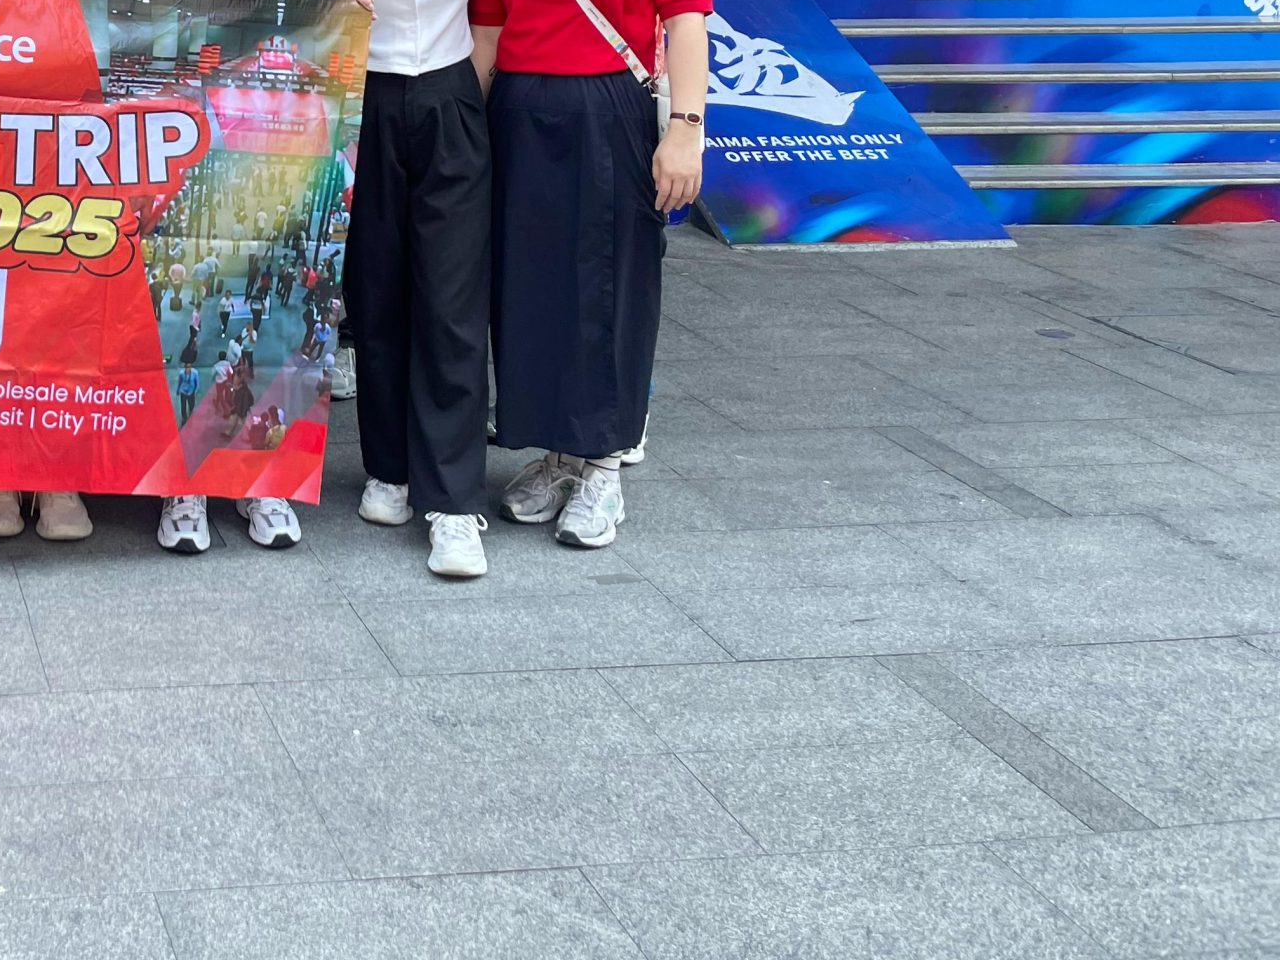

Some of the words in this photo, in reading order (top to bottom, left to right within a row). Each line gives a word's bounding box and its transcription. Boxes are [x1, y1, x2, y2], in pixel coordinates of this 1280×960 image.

[0, 108, 202, 188] TRIP
[702, 135, 756, 148] AIMA
[757, 134, 848, 147] FASHION
[851, 132, 904, 145] ONLY
[724, 151, 796, 163] OFFER
[798, 149, 837, 161] THE
[842, 148, 890, 160] BEST
[75, 382, 146, 406] Market
[42, 409, 83, 434] City
[89, 412, 127, 435] Trip
